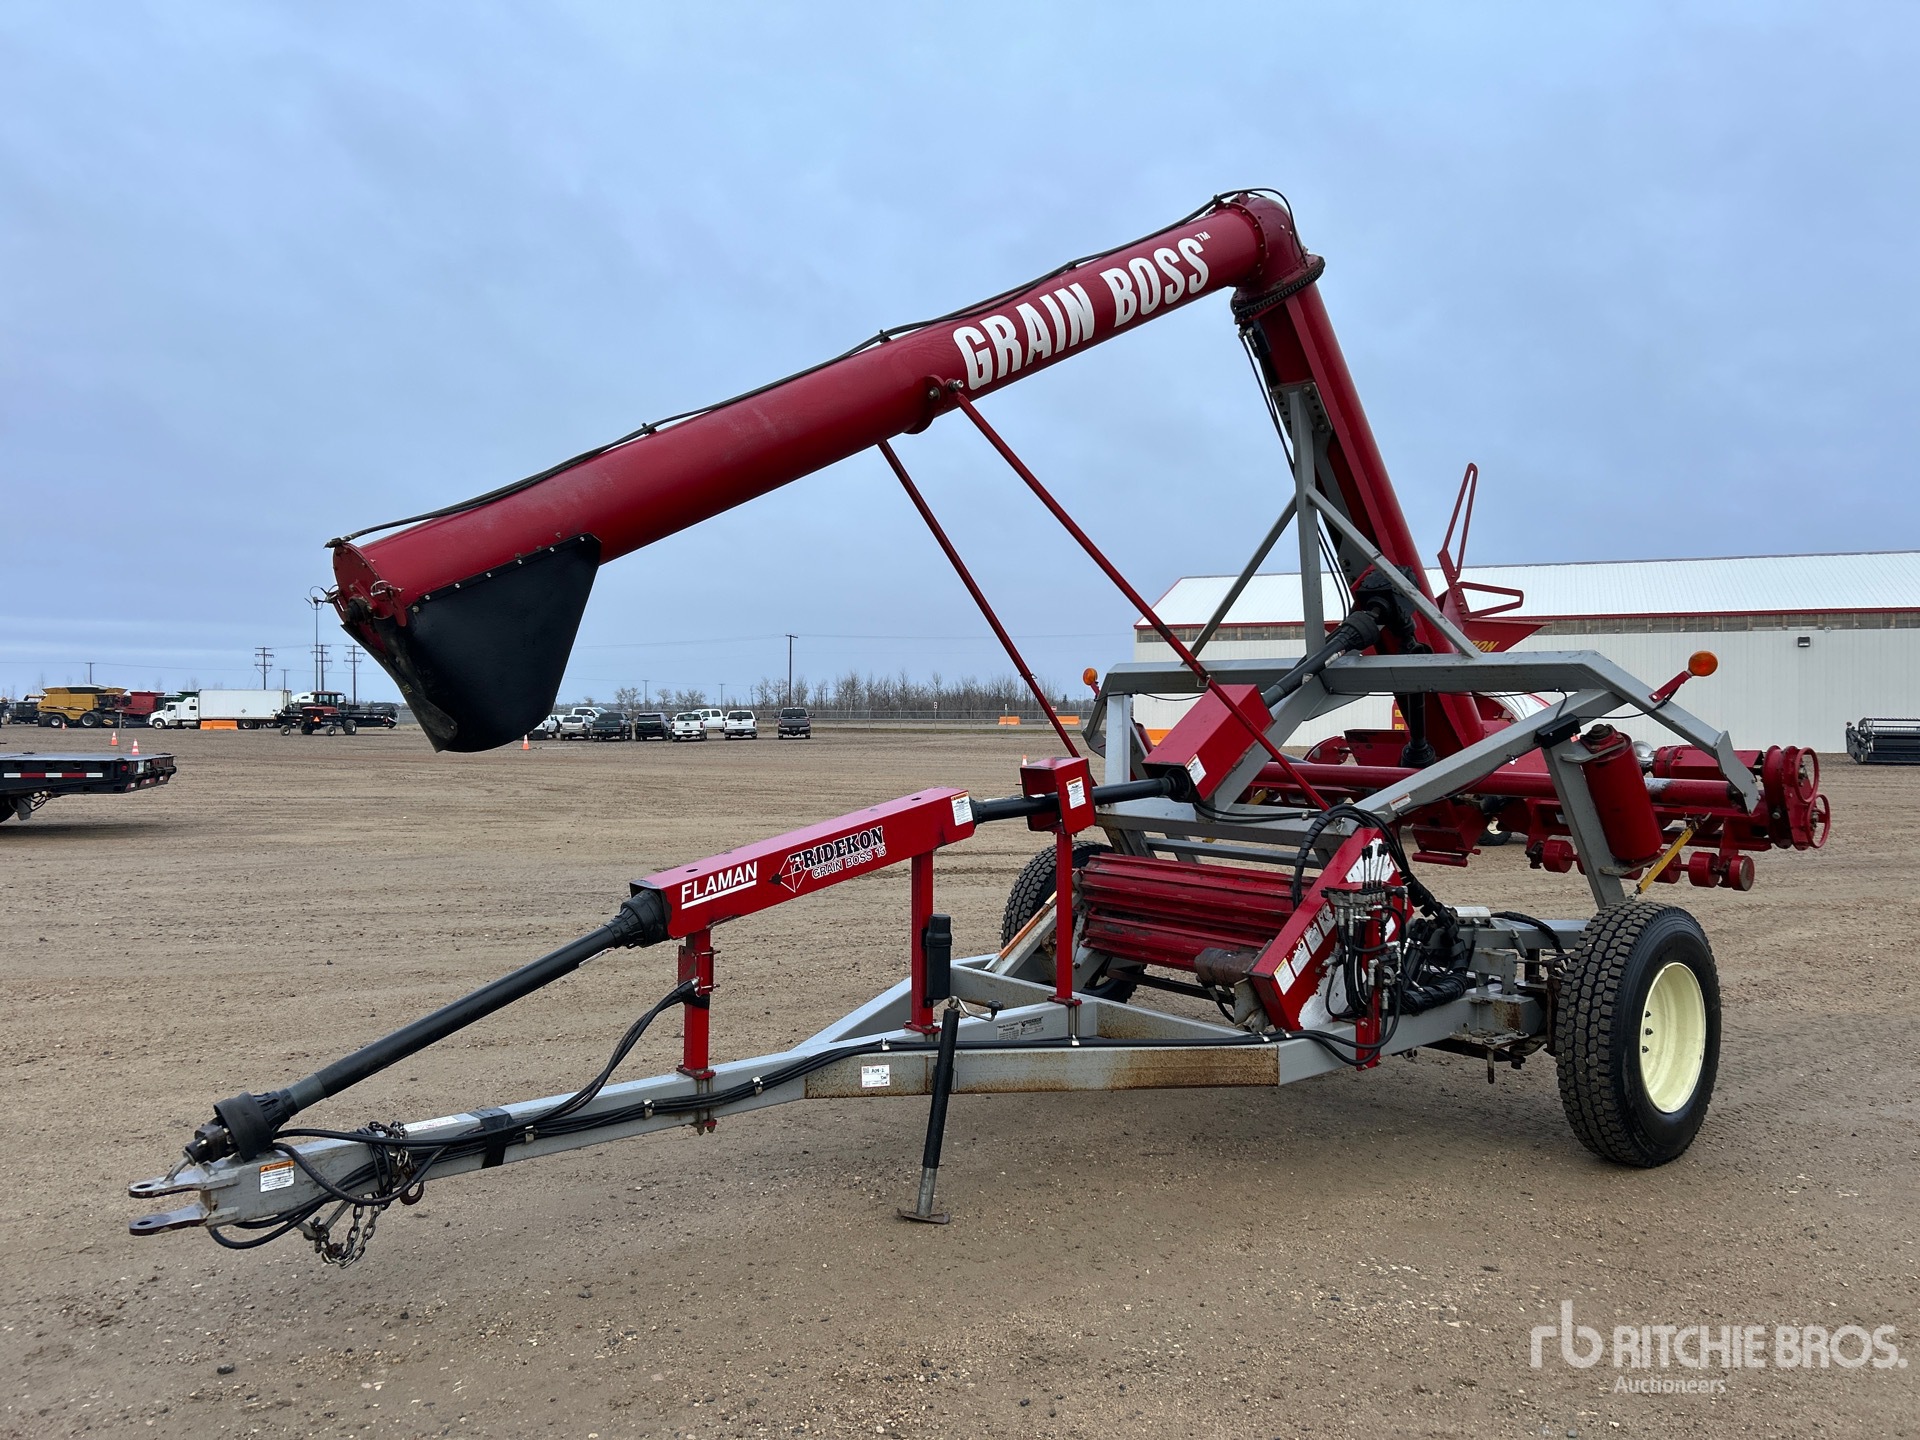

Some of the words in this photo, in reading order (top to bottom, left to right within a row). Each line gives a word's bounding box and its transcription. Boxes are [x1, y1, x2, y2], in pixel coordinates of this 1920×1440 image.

[952, 282, 1095, 390] GRAIN
[789, 825, 885, 872] TRIDEKON
[811, 861, 844, 879] GRAIN
[846, 850, 873, 869] BOSS
[681, 861, 758, 903] FLAMAN
